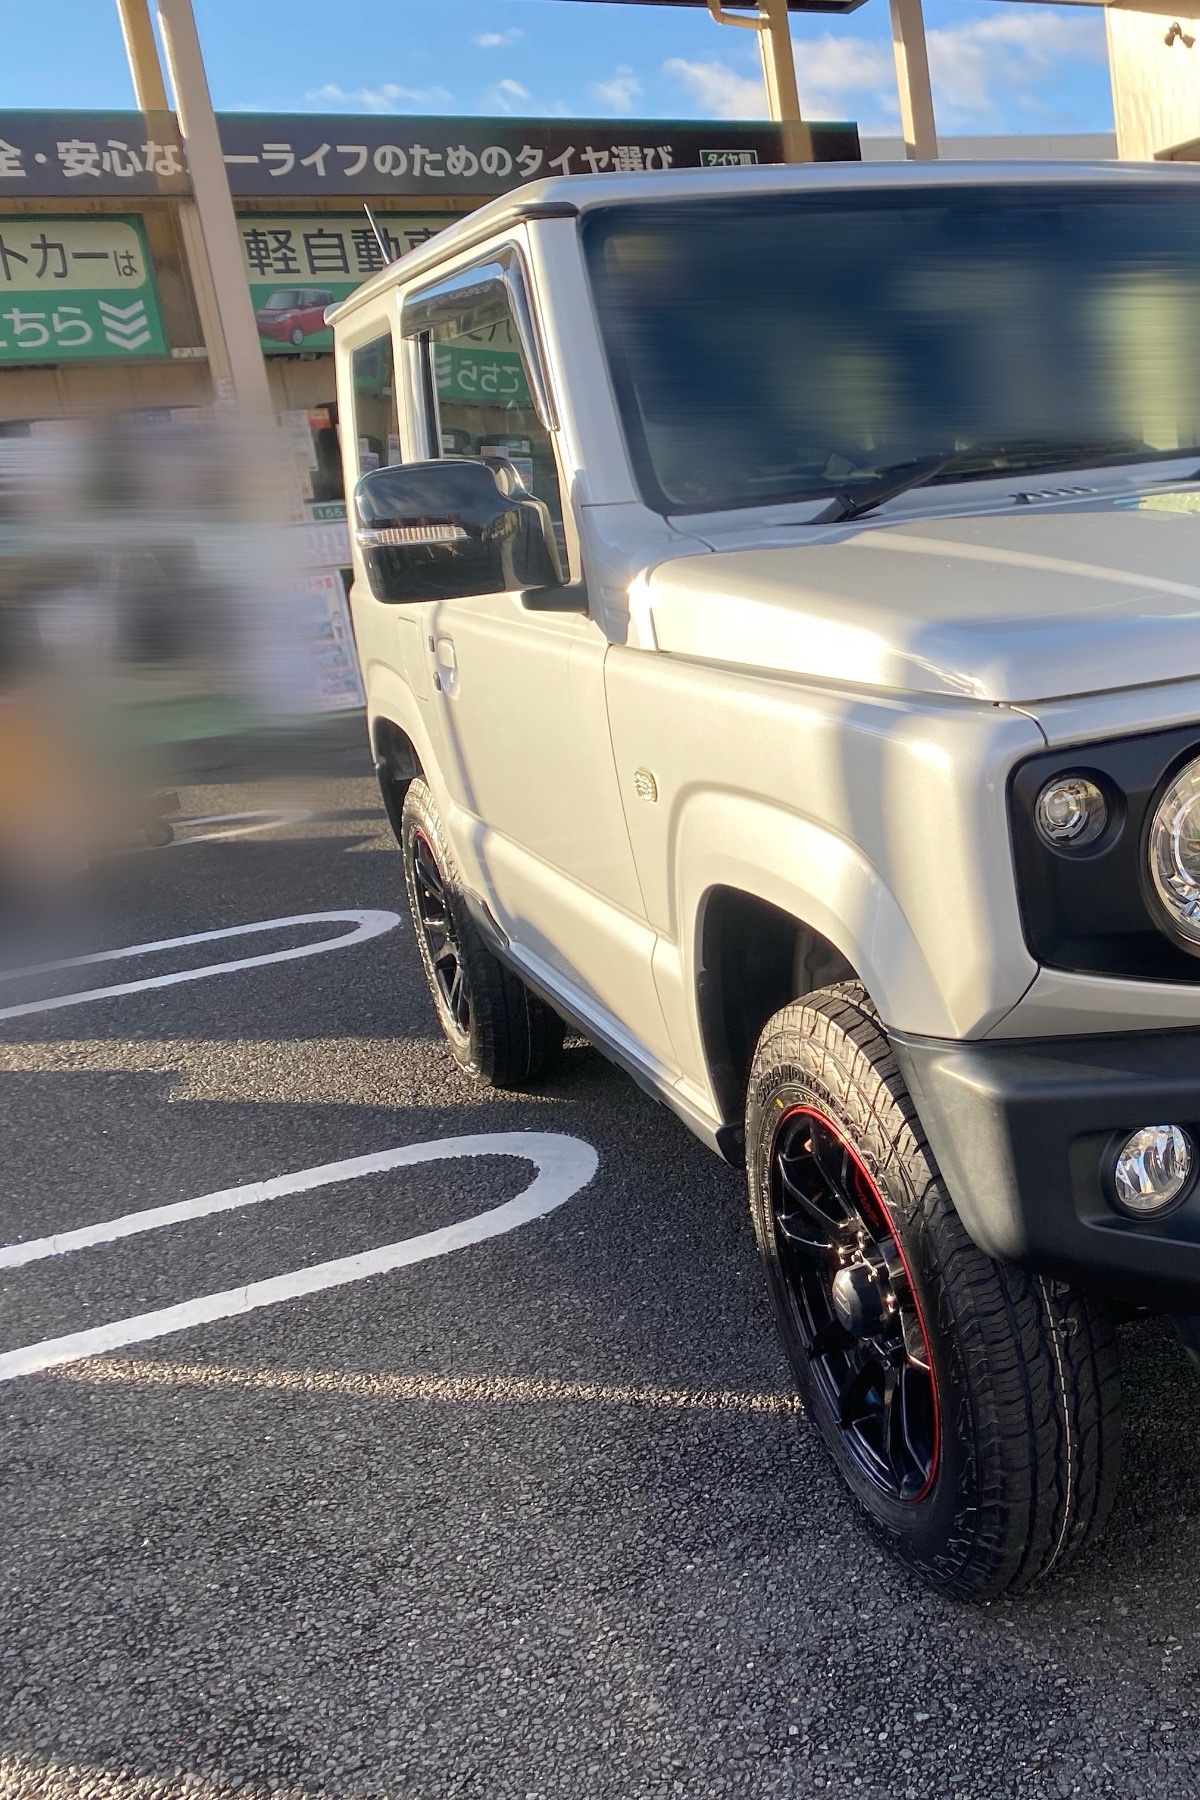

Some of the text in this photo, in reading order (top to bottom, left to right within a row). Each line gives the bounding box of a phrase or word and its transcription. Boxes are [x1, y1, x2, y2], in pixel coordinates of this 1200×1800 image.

[0, 139, 673, 177] 全・安心なーライフのためのタイヤ選び
[707, 152, 751, 166] タイヤ館
[0, 308, 93, 347] ちら
